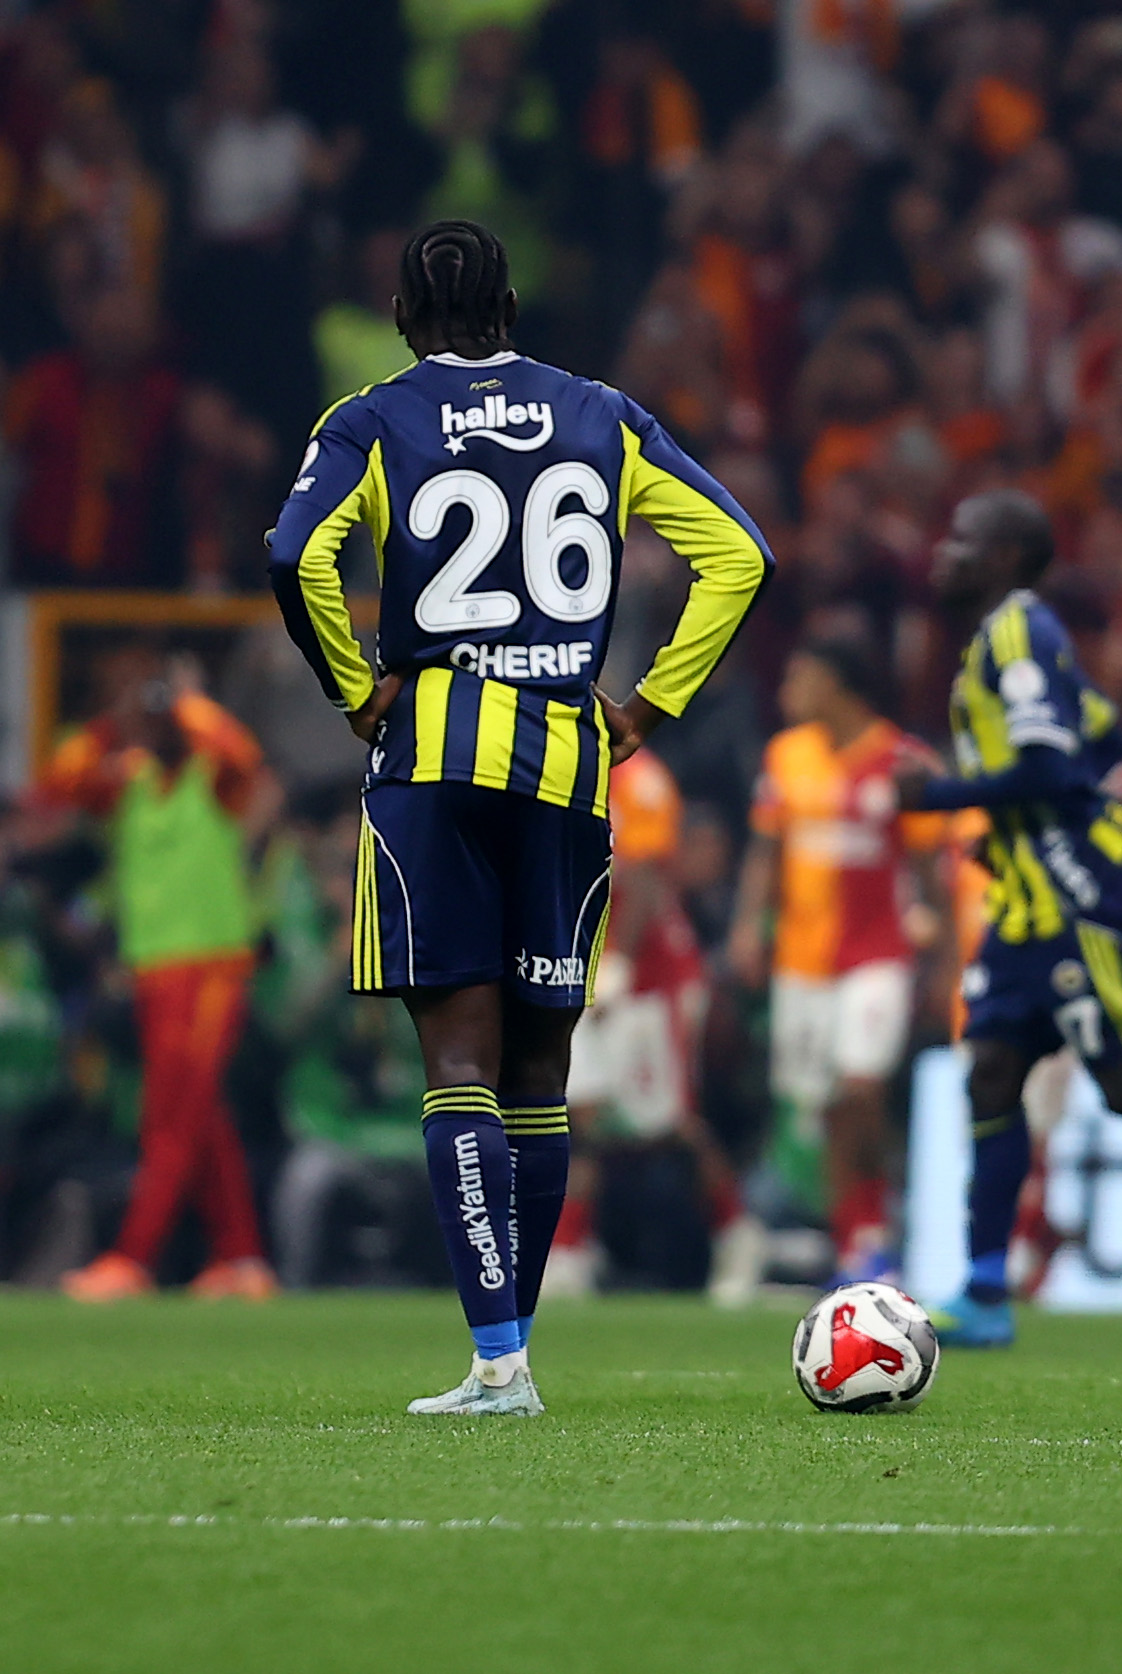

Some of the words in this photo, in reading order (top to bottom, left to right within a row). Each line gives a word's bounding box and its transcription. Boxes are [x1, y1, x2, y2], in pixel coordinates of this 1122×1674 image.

[441, 394, 554, 452] halley
[409, 461, 612, 633] 26
[450, 641, 593, 678] CHERIF
